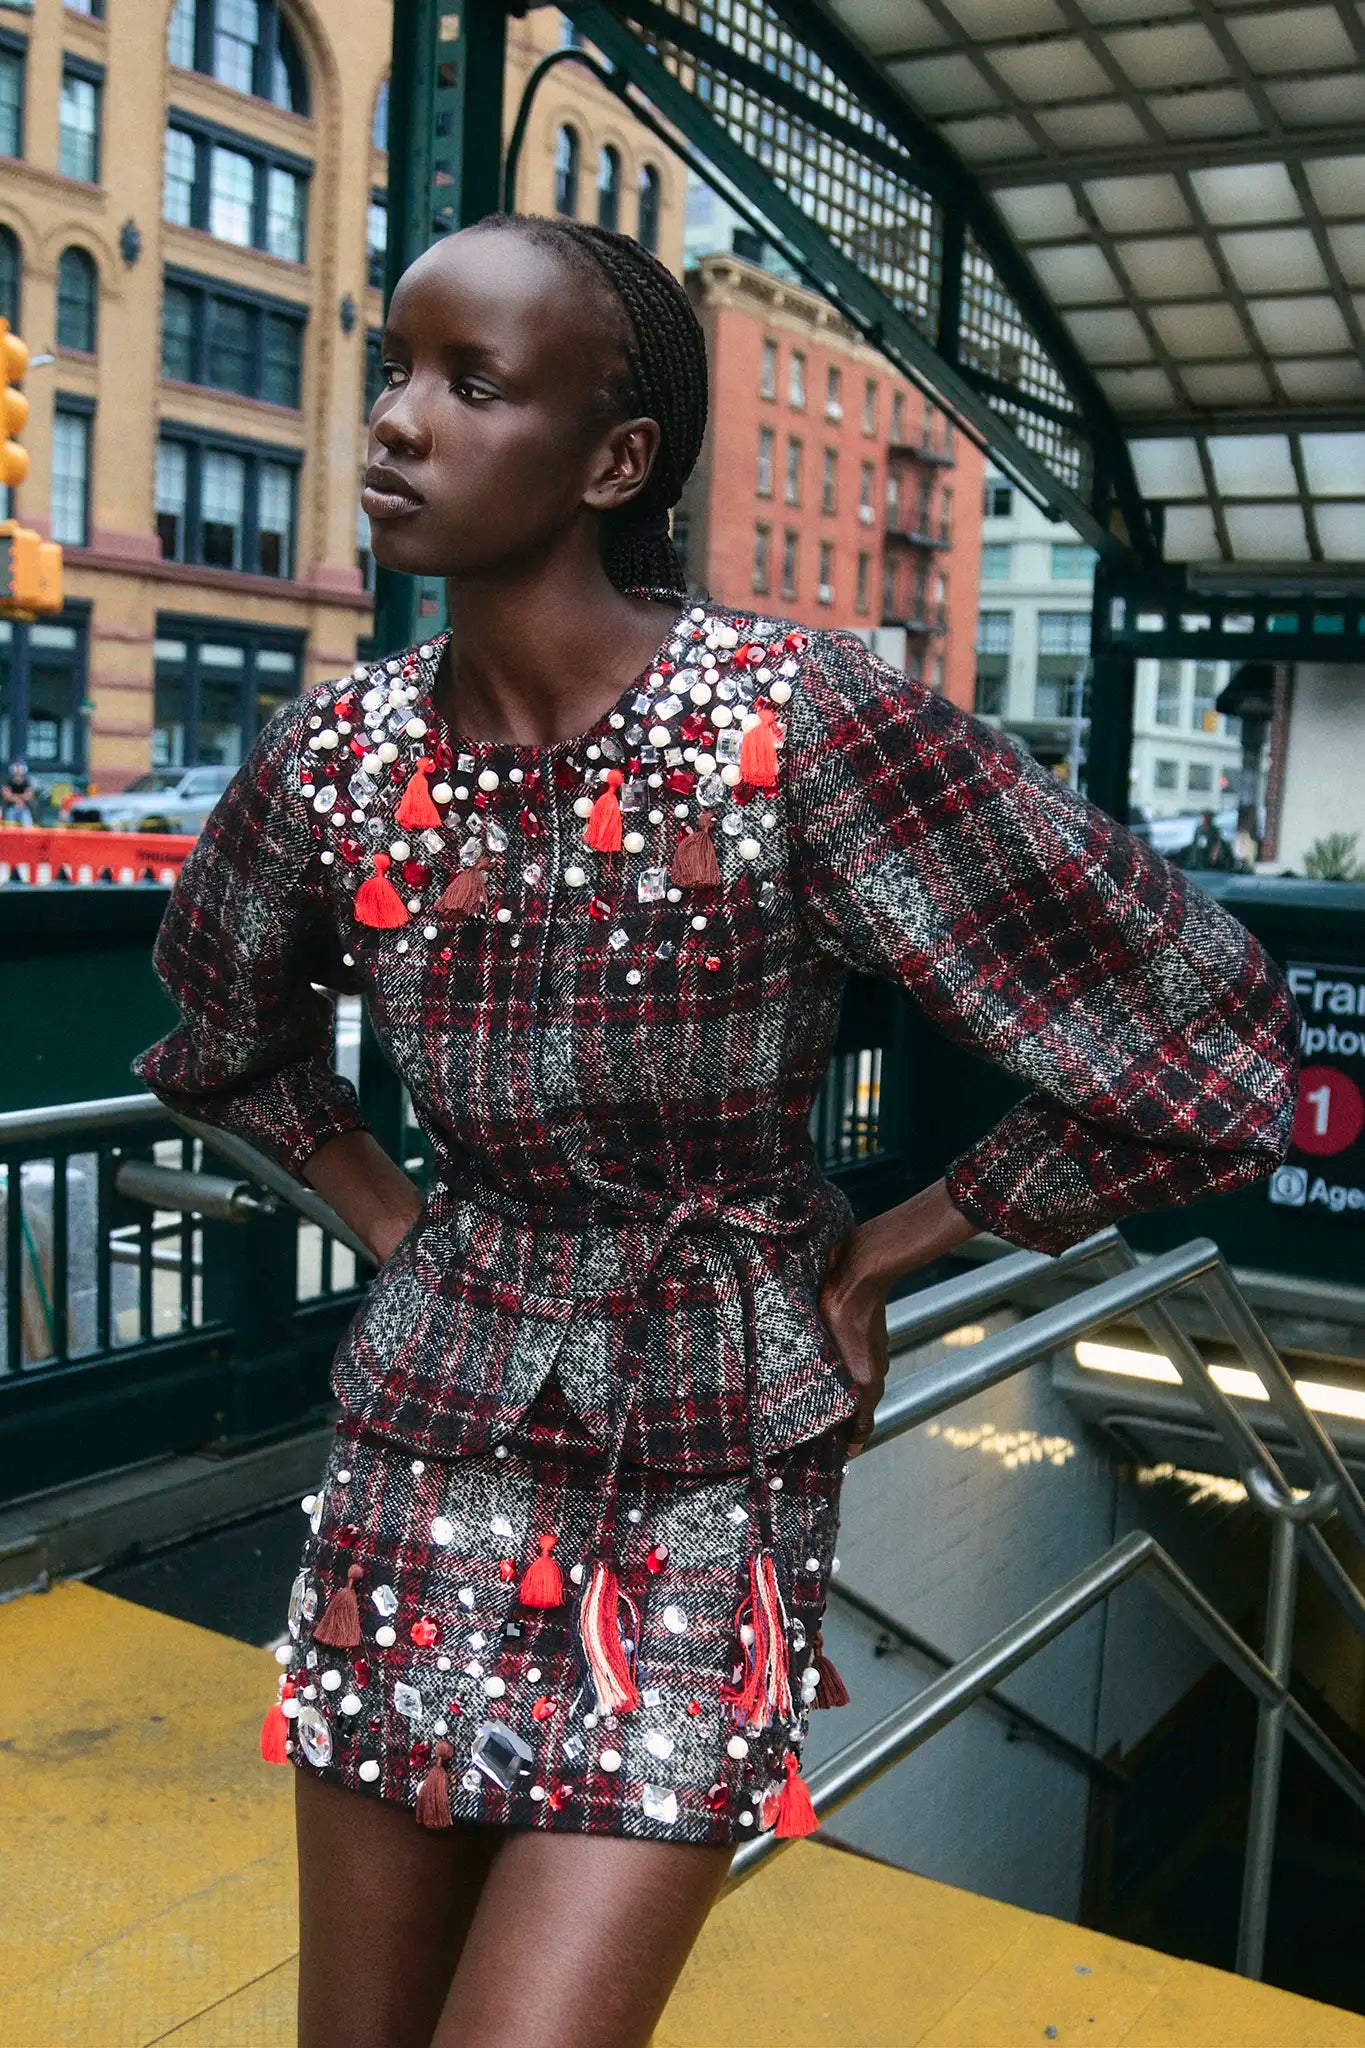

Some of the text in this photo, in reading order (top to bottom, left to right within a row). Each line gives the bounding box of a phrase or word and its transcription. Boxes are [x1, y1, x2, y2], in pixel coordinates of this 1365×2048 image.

[1301, 1020, 1365, 1056] pto
[1307, 1085, 1331, 1135] 1
[1308, 1177, 1365, 1212] Age
